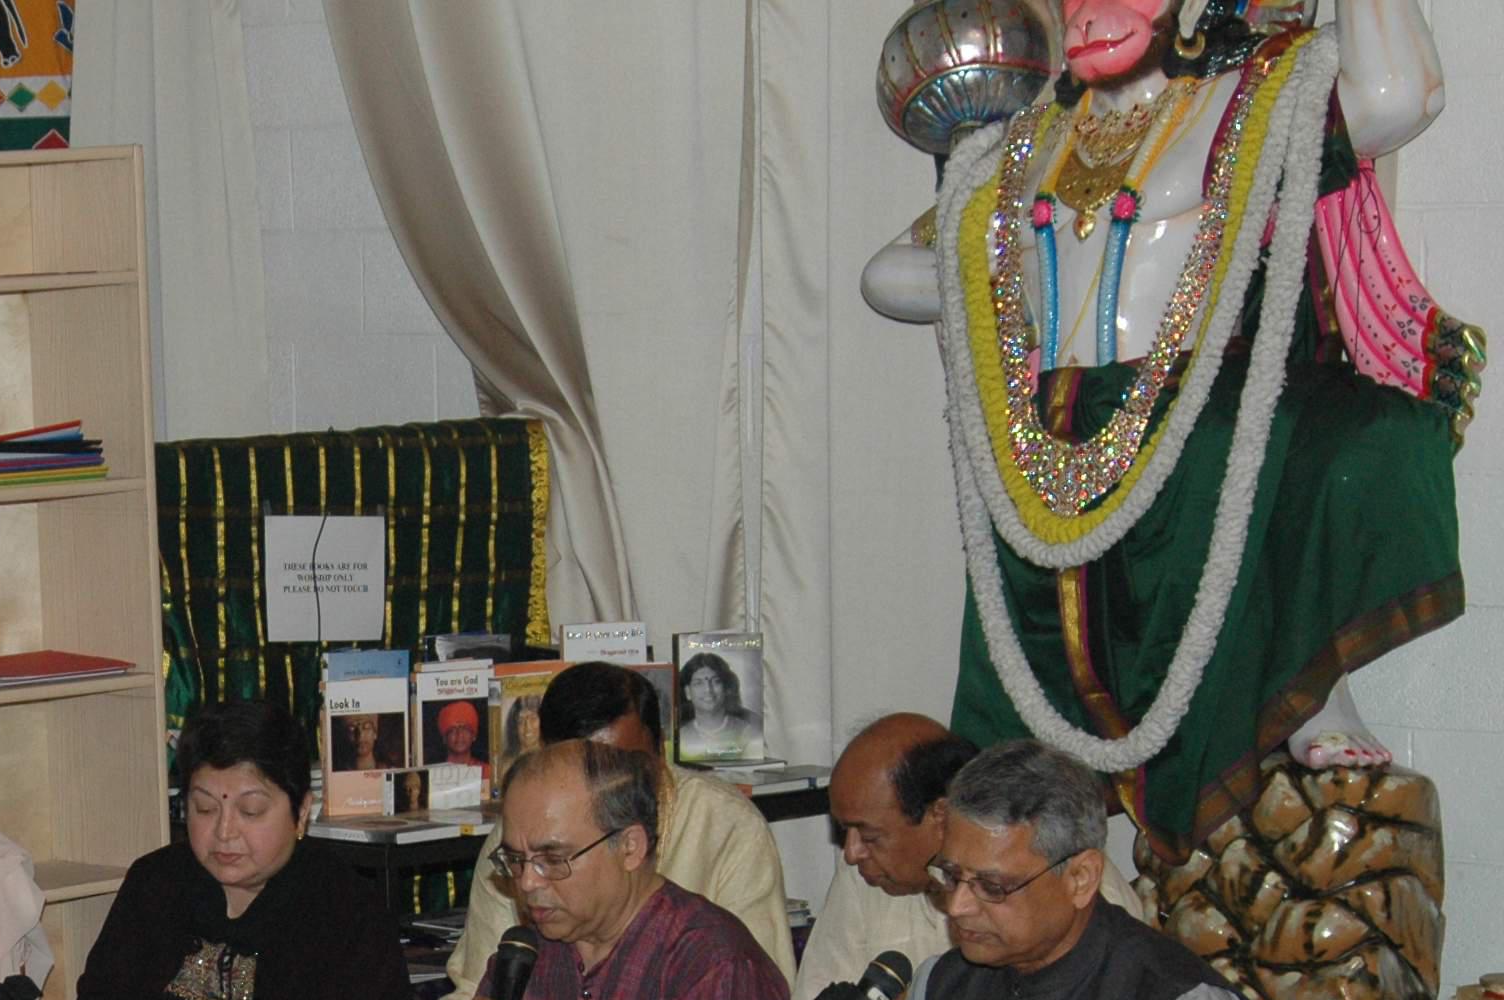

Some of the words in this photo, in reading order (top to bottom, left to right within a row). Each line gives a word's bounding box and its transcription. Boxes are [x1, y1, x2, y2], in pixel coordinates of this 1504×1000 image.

[353, 562, 368, 571] FOR
[334, 573, 353, 582] ONLY
[283, 585, 311, 593] PLEASE
[325, 585, 341, 593] NOT
[343, 585, 369, 593] TOUCH
[435, 676, 449, 687] You
[450, 678, 462, 686] are
[463, 674, 479, 685] God
[329, 697, 349, 710] Look
[351, 698, 361, 709] In
